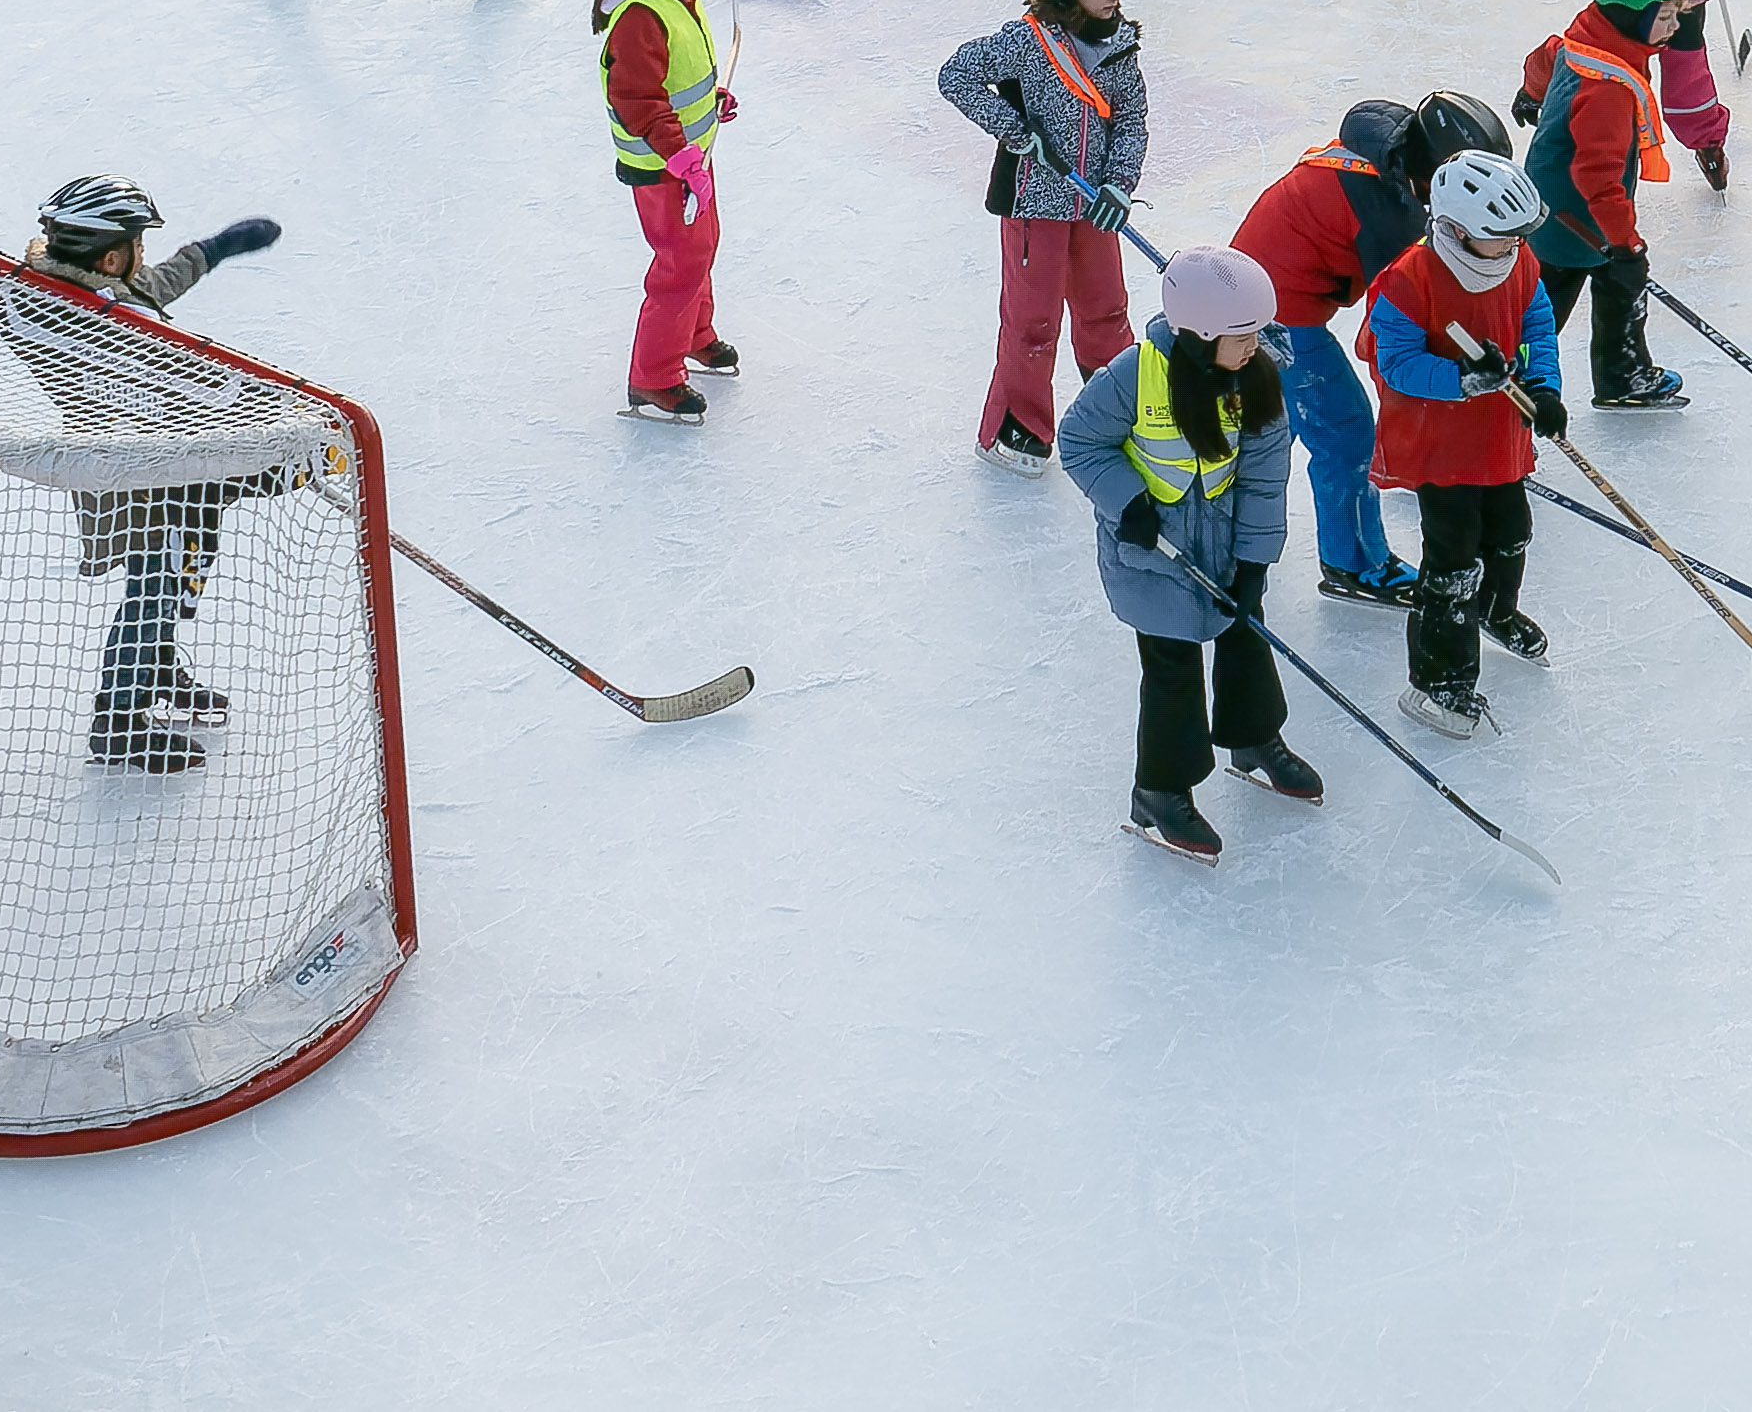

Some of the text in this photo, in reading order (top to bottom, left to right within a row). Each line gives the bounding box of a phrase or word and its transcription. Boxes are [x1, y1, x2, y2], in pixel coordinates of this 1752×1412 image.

[1668, 557, 1732, 619] FISCHER
[1681, 556, 1731, 585] CHER
[295, 945, 338, 986] ergo
